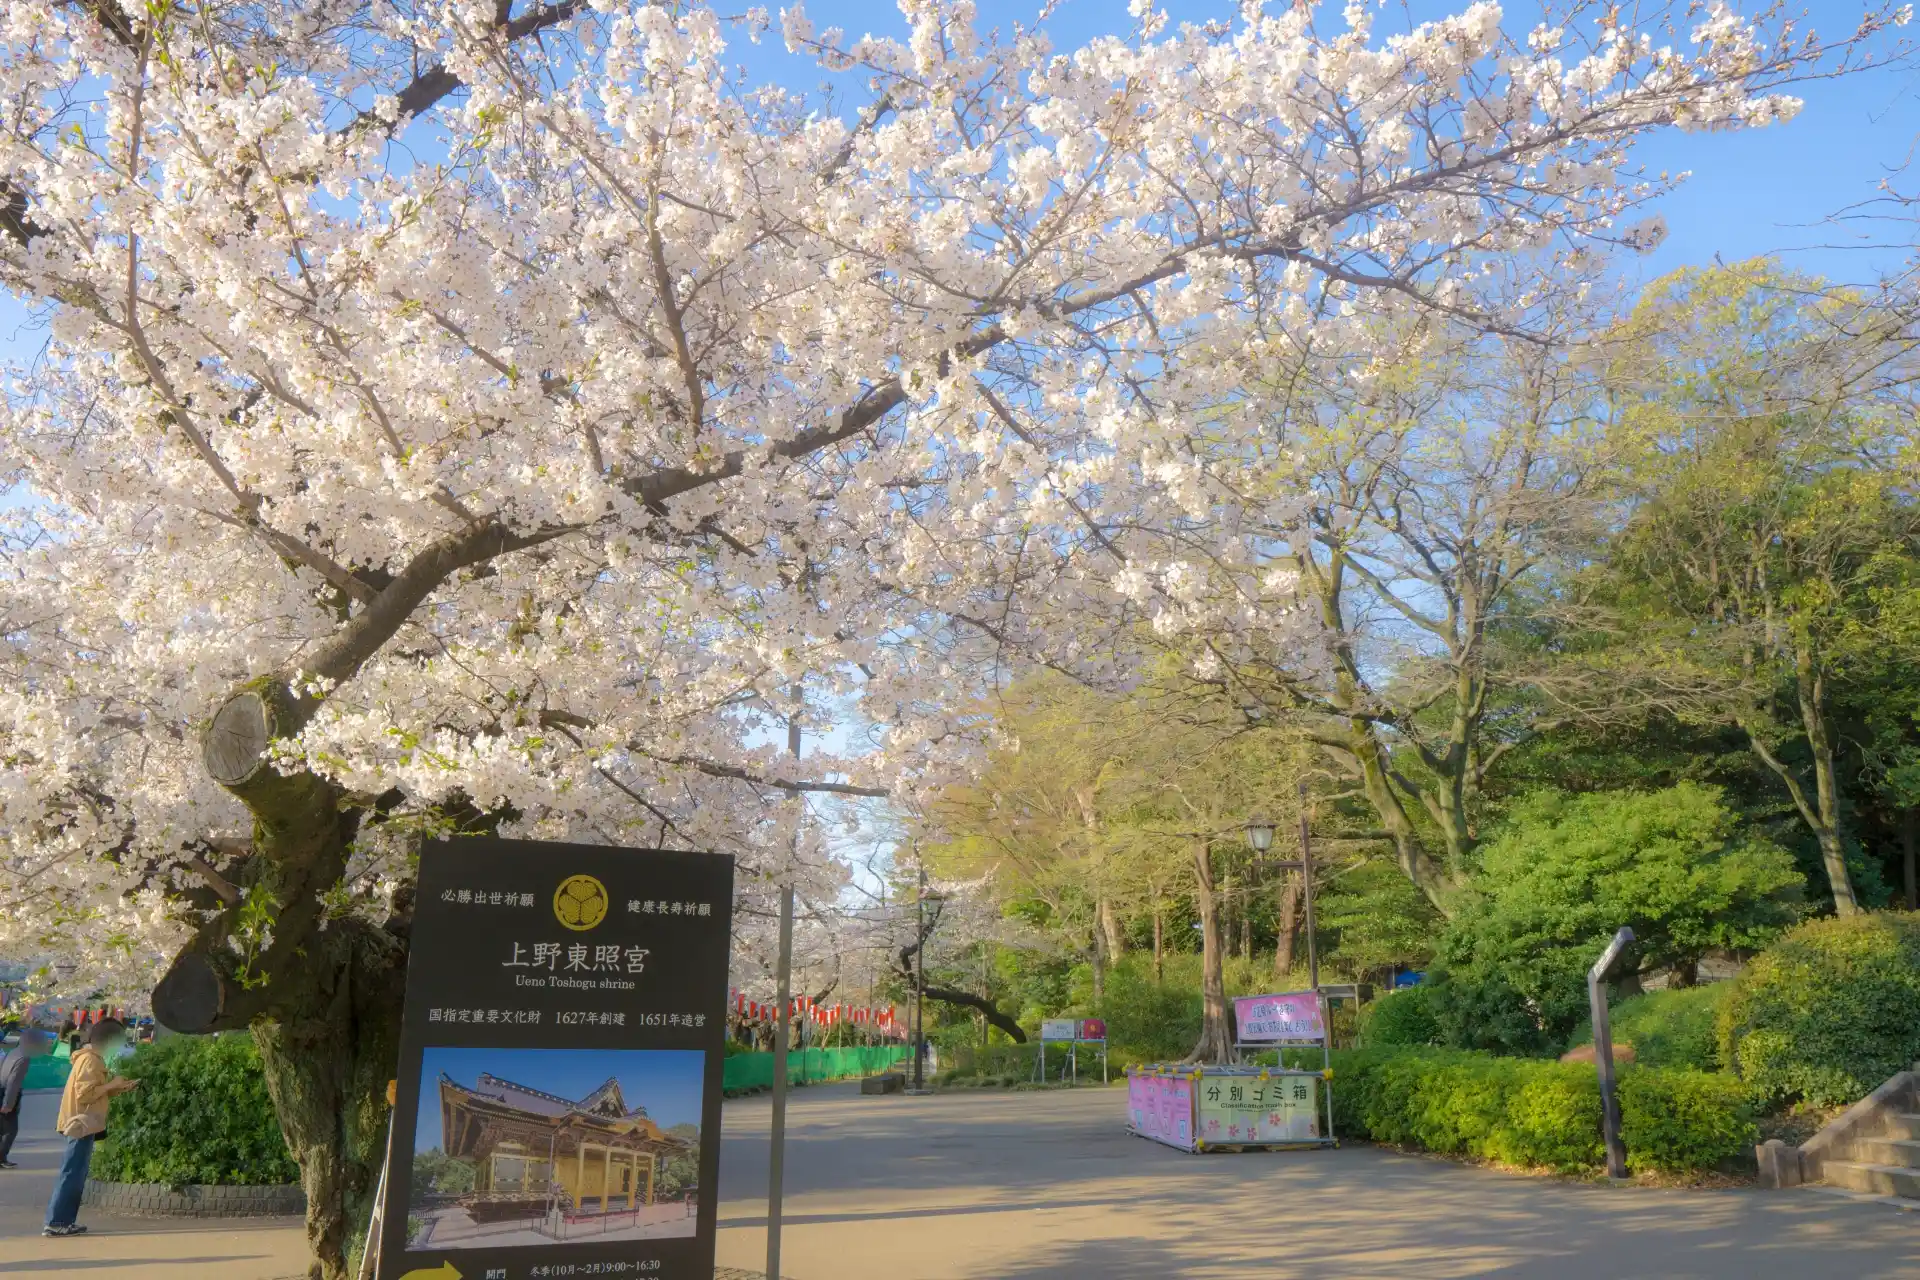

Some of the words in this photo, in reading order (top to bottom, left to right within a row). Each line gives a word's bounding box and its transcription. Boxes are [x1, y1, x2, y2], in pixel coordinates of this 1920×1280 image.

[441, 889, 534, 907] 必勝出世祈願
[628, 900, 711, 917] 健康長寿祈願
[502, 941, 650, 974] 上野東照宮
[515, 975, 546, 987] Ueno
[549, 976, 596, 990] Toshogu
[600, 978, 635, 989] shrine
[429, 1008, 541, 1024] 国指定重要文化財
[556, 1011, 626, 1026] 1627年創建
[639, 1013, 706, 1027] 1651年造営
[1207, 1085, 1307, 1101] 分別ゴミ箱
[1220, 1102, 1264, 1110] Classification
[486, 1268, 506, 1280] 開門
